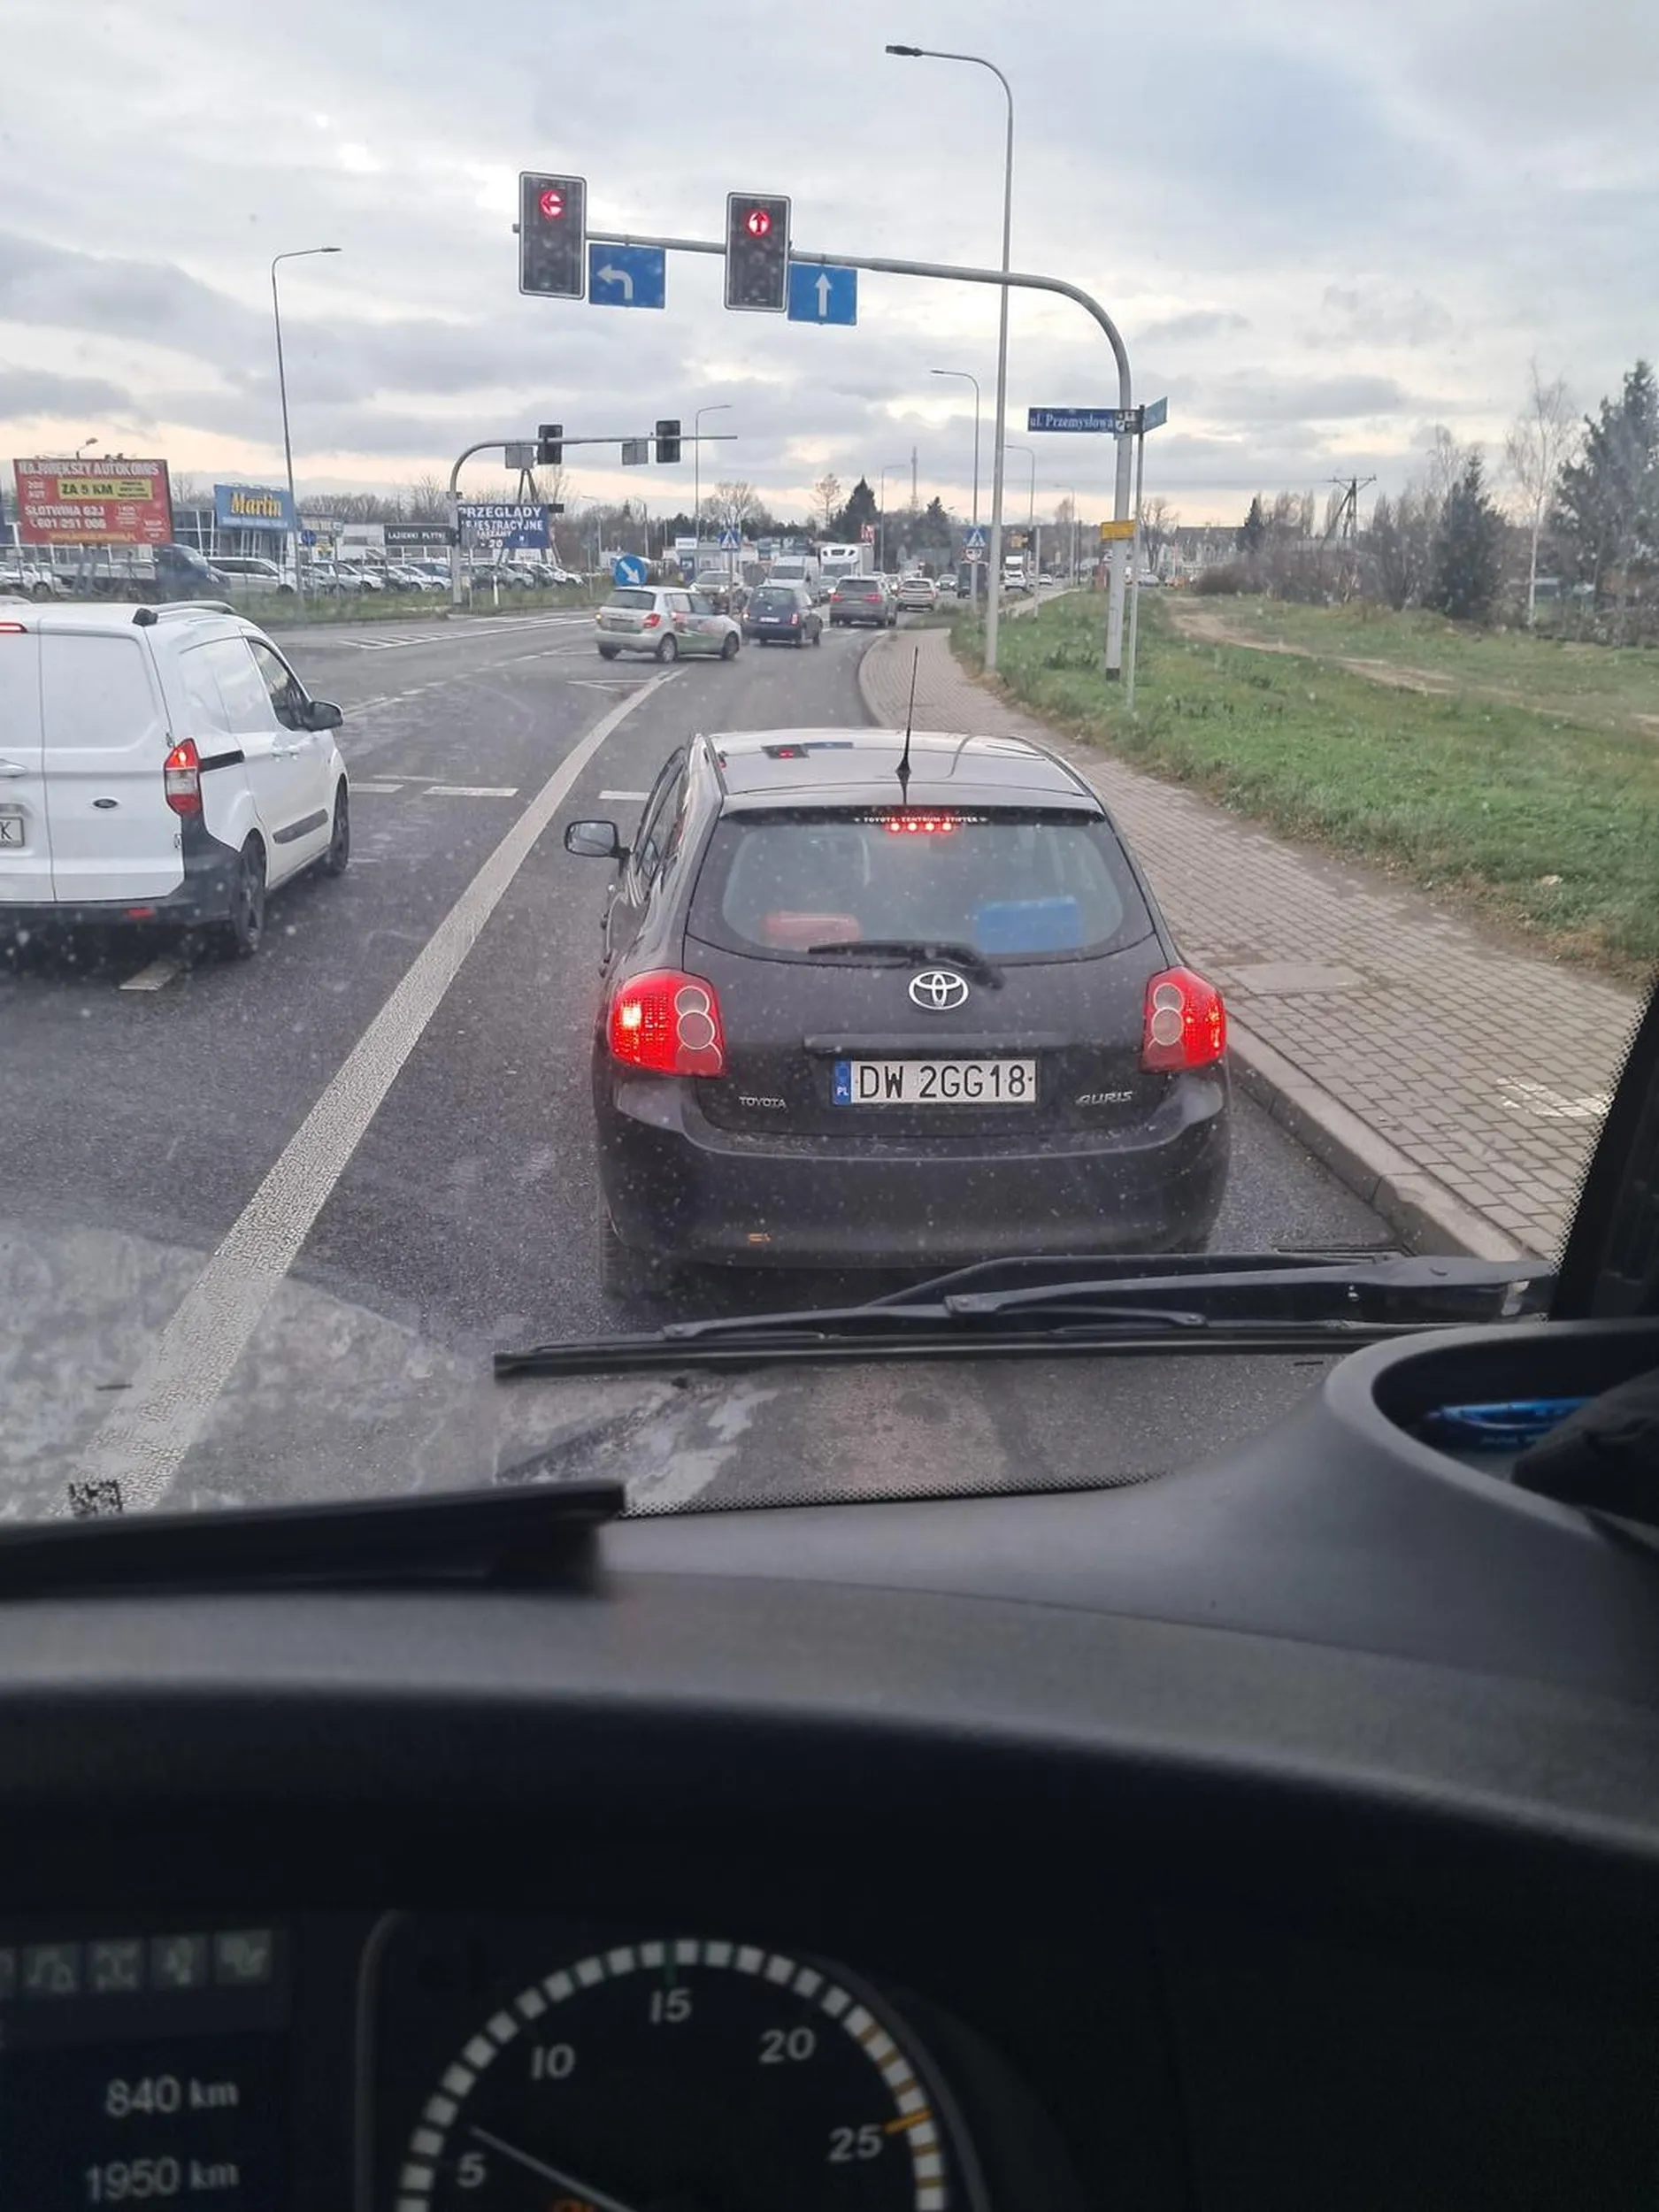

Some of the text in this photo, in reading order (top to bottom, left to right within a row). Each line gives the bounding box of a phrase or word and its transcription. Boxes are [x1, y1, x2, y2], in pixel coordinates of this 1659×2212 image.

[1046, 413, 1113, 430] Przemysłowa
[61, 483, 78, 495] ZA
[81, 484, 88, 495] 5
[92, 483, 113, 495] KM
[836, 1087, 849, 1096] PL
[858, 1064, 1025, 1098] DW 2GG18
[1076, 1091, 1133, 1106] AURIS
[739, 1095, 787, 1109] TOYOTA
[649, 1987, 693, 2024] 15
[532, 2043, 576, 2080] 10
[758, 2028, 816, 2064] 20
[104, 2074, 239, 2119] 840 km
[827, 2124, 884, 2162] 25
[86, 2156, 240, 2204] 1950 km
[456, 2152, 486, 2189] 5
